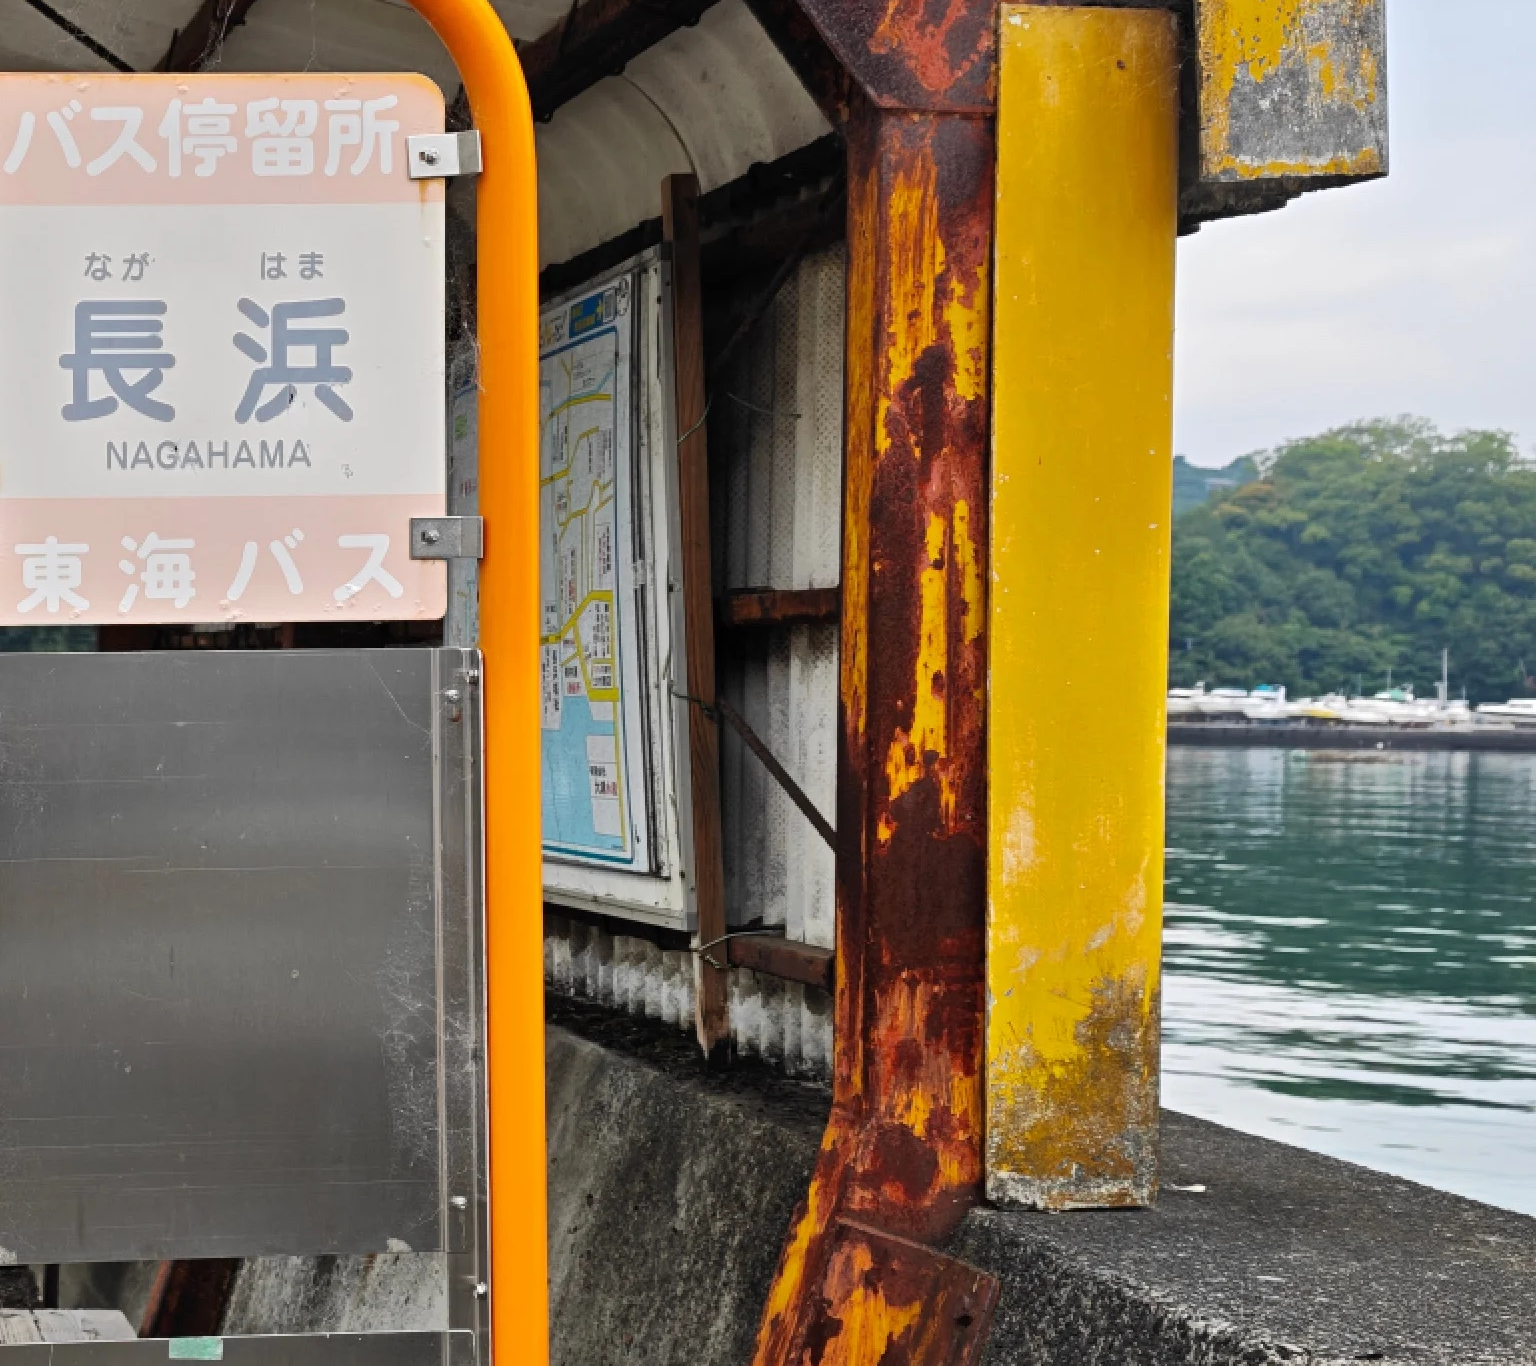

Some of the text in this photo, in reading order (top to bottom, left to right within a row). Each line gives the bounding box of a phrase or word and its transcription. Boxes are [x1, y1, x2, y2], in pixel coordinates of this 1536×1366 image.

[2, 93, 401, 178] バス停留所
[83, 251, 325, 282] なが はま
[58, 296, 354, 424] 長浜
[105, 438, 312, 471] NAGAHAMA
[13, 527, 404, 614] 東海バス
